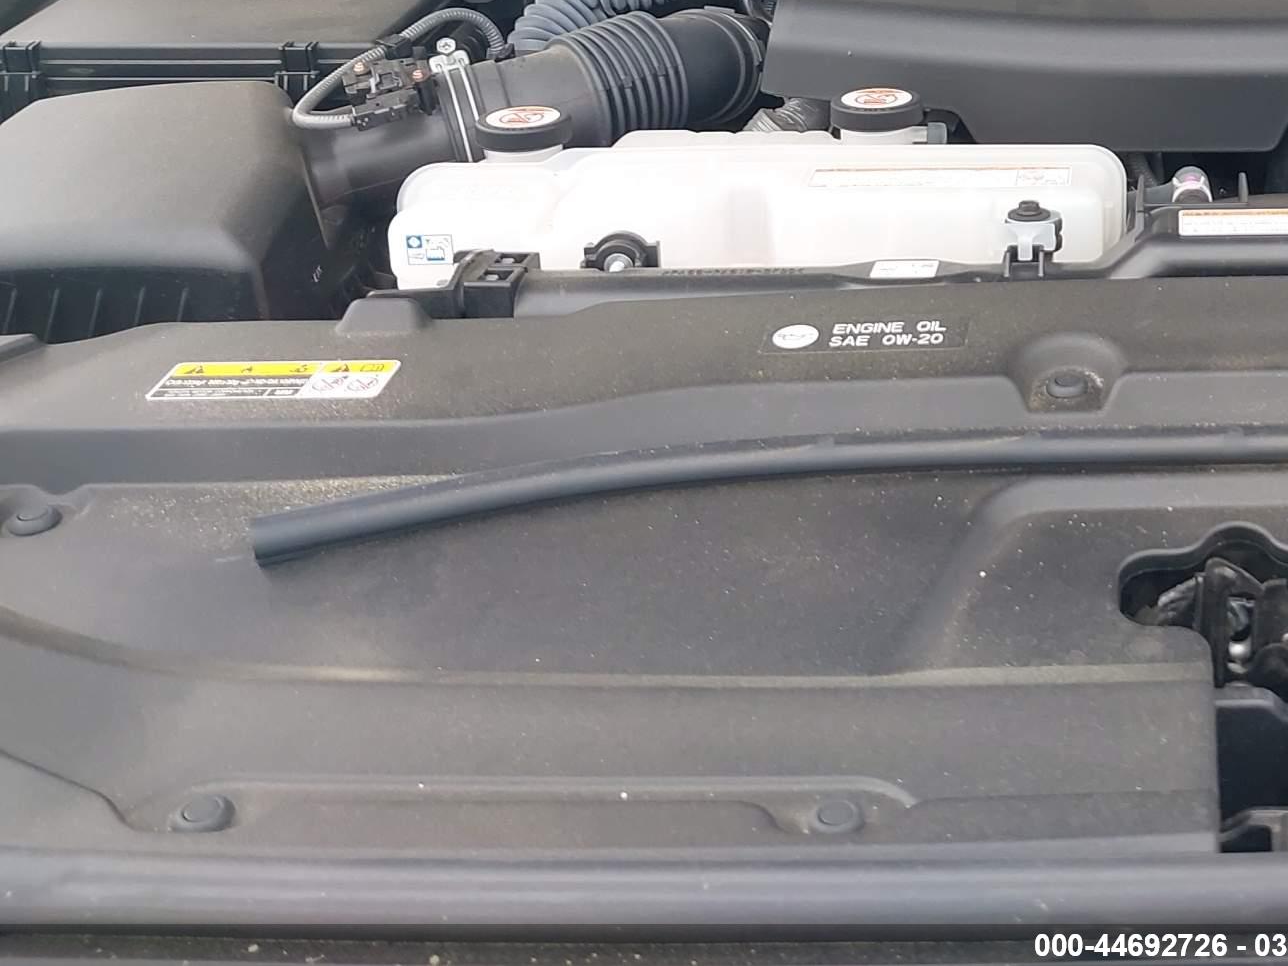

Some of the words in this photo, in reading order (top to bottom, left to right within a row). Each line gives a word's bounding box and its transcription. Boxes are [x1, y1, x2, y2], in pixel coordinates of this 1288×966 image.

[832, 321, 905, 335] ENGINE
[916, 320, 947, 333] OIL
[828, 335, 870, 347] SAE
[881, 333, 944, 346] 0W-20
